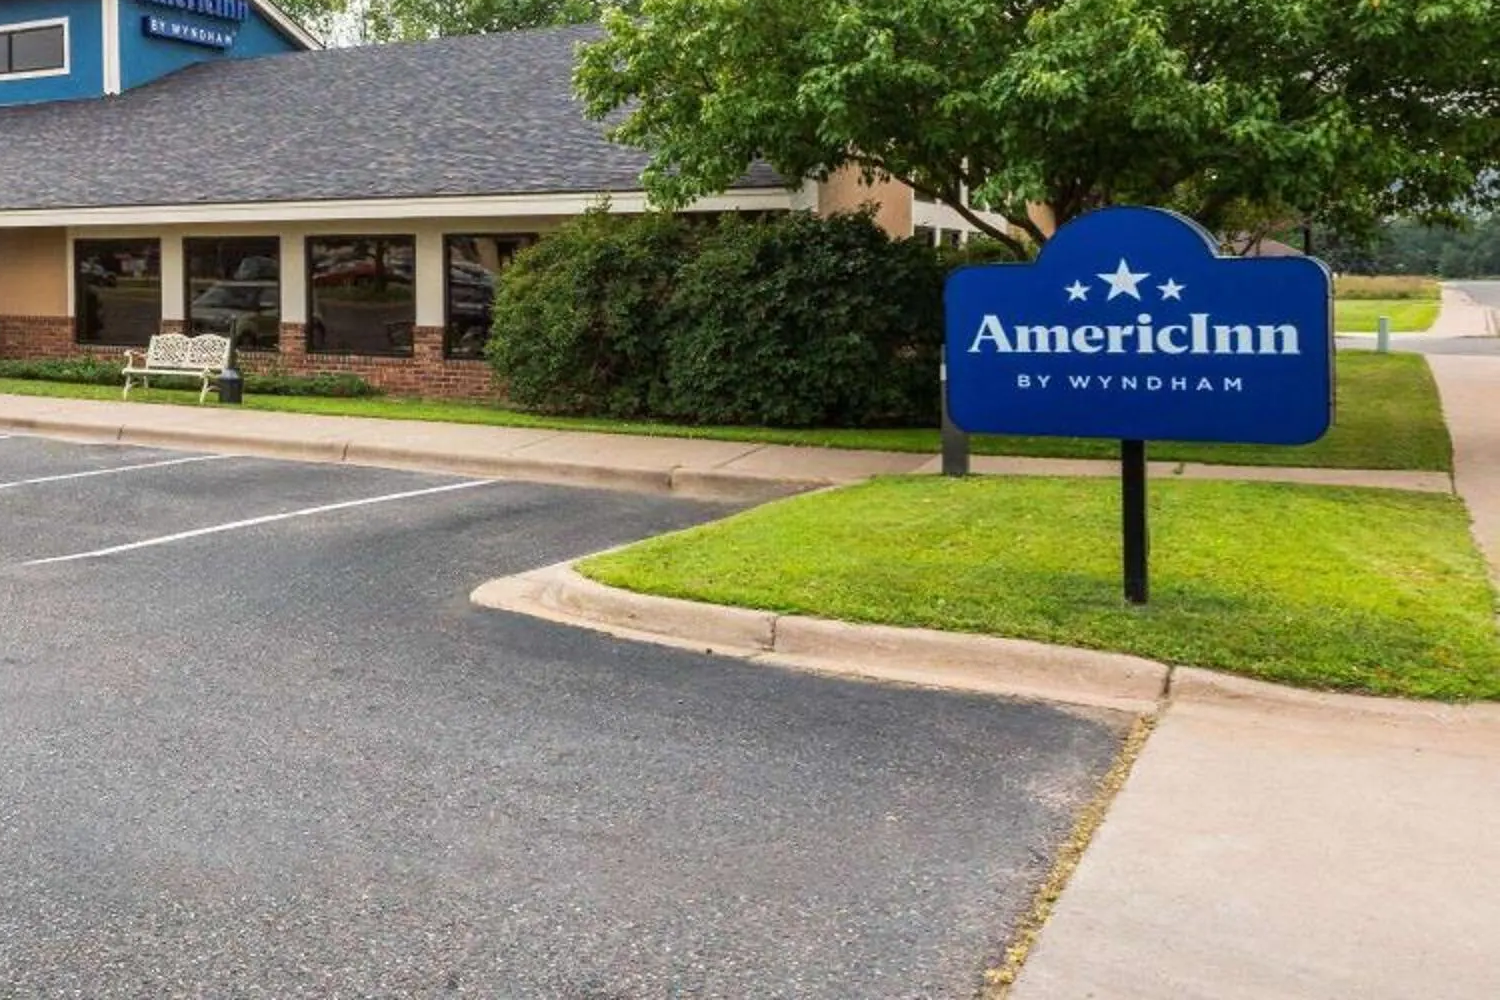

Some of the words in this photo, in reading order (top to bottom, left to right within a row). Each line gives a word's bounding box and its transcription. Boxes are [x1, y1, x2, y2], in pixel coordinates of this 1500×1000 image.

[150, 18, 165, 32] BY
[967, 313, 1300, 355] AmericInn
[1017, 374, 1050, 389] BY
[1069, 375, 1243, 391] WYNDHAM
